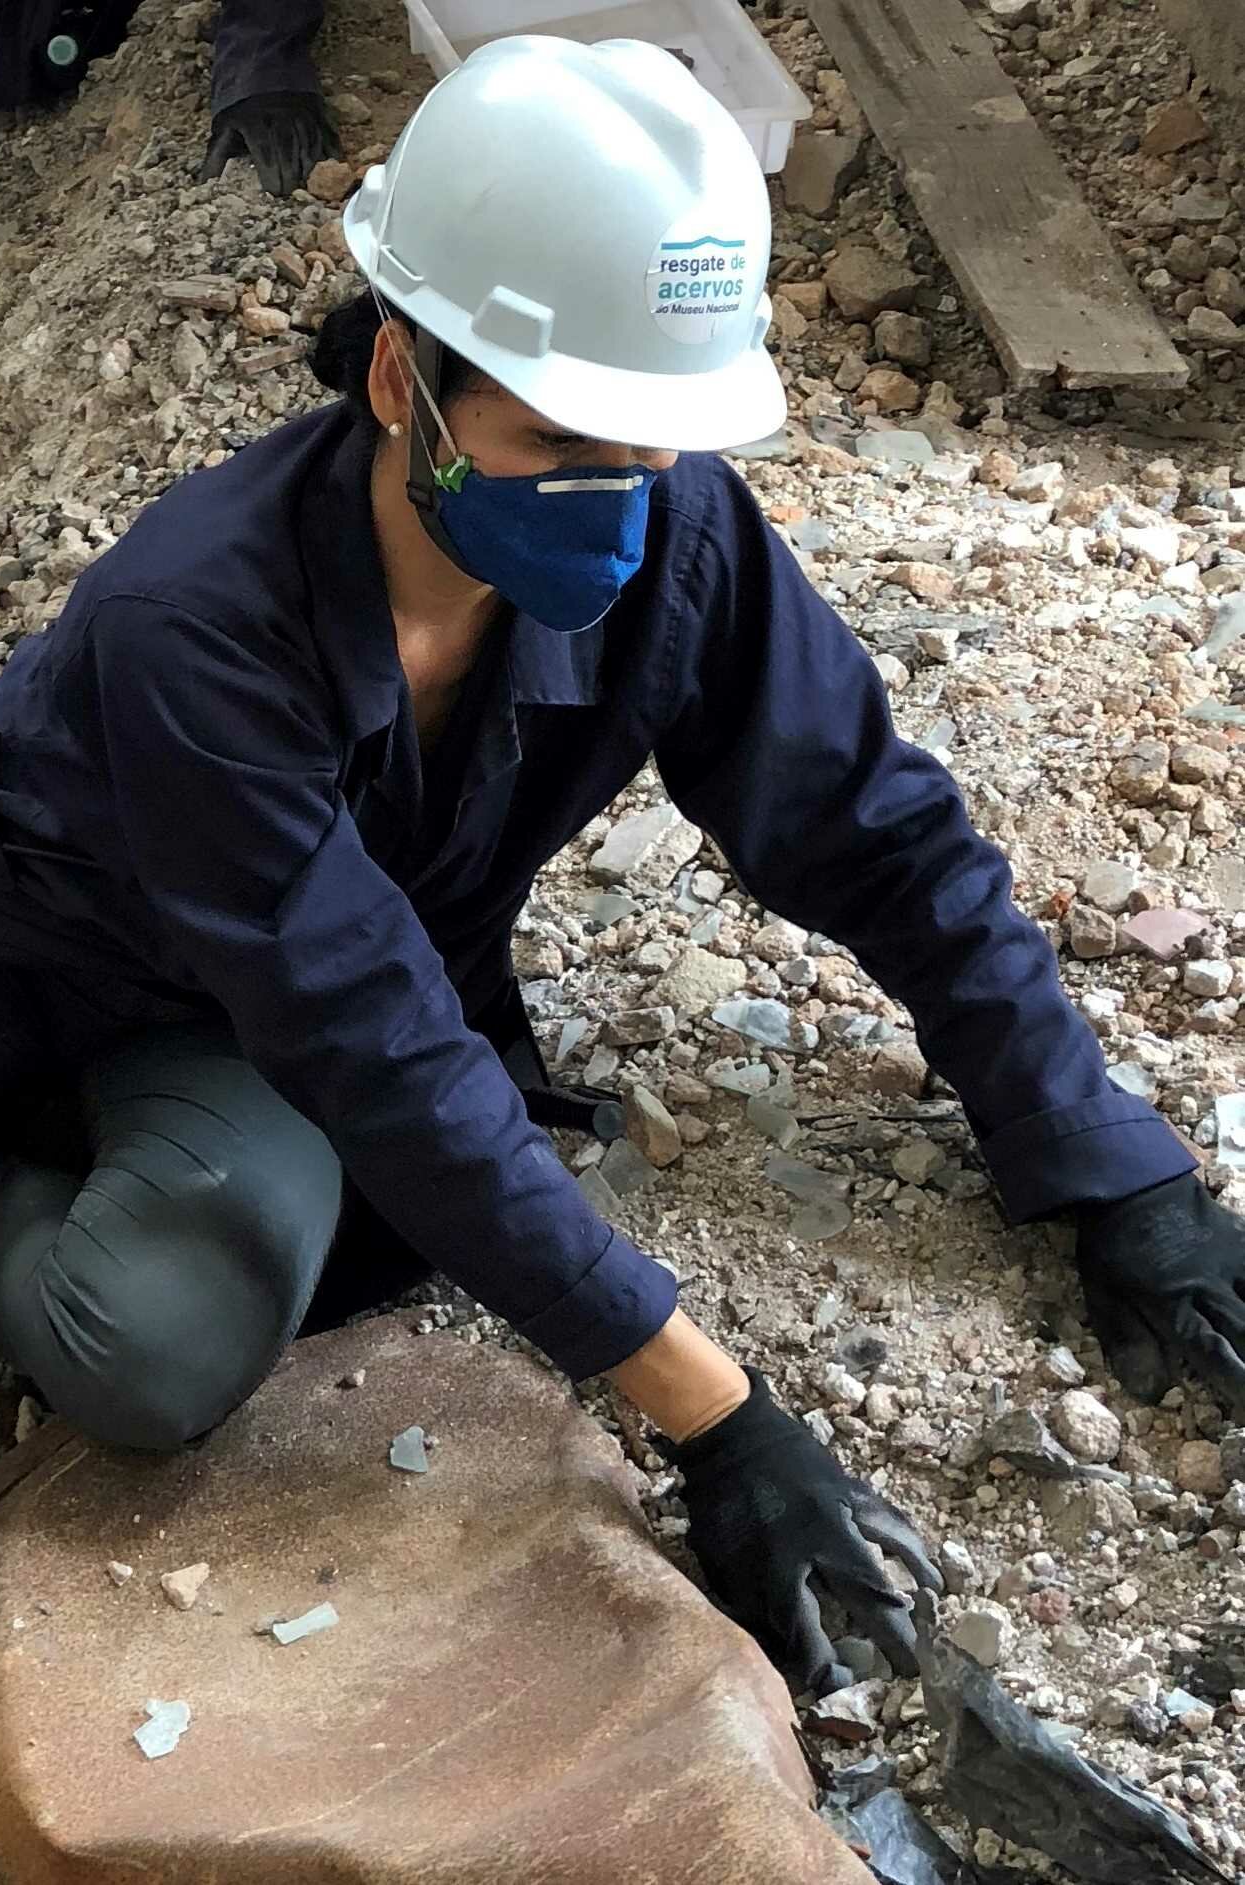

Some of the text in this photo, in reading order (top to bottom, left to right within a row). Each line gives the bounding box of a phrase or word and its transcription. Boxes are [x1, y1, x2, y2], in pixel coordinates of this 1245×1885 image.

[660, 252, 746, 276] resgate de
[658, 279, 743, 299] acervos
[671, 304, 705, 315] Museu
